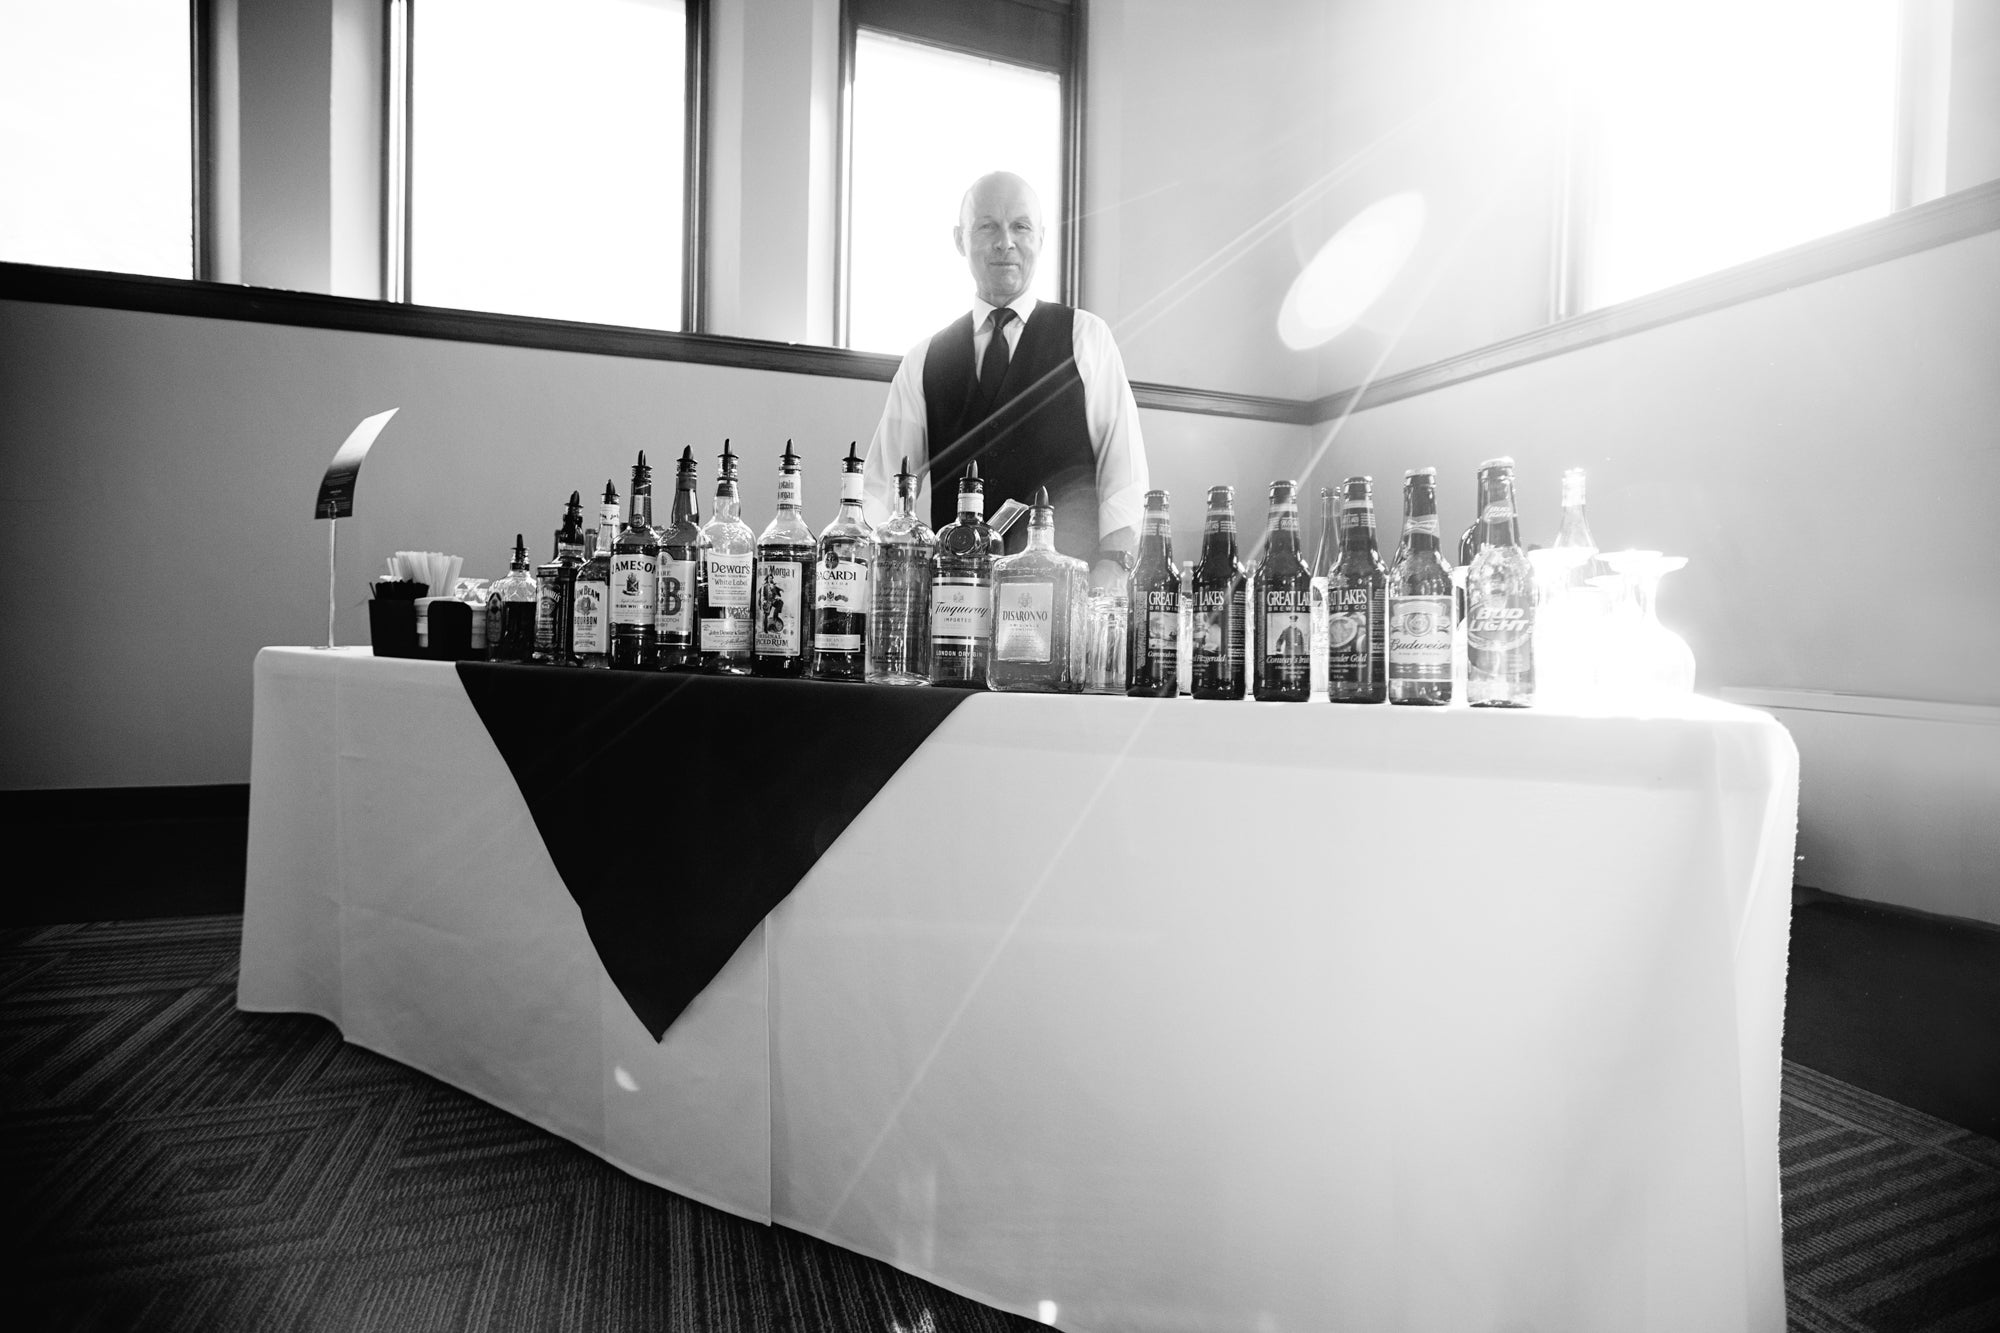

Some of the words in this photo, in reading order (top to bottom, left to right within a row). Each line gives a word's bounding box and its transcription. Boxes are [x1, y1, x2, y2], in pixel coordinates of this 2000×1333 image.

[711, 561, 751, 575] Dewar's
[583, 584, 600, 601] BEAM
[1149, 591, 1174, 605] GREAT
[1200, 591, 1224, 605] LAKES
[1267, 591, 1295, 606] GREAT
[1340, 589, 1367, 605] LAKES
[935, 601, 988, 618] Tanqueray
[1002, 610, 1048, 622] DISARONNO
[1476, 607, 1524, 620] BUD
[1470, 620, 1530, 632] LIGHT
[771, 639, 788, 647] RUM
[1391, 639, 1451, 651] Budweiser
[936, 649, 957, 657] LONDON
[1350, 653, 1368, 662] Gold
